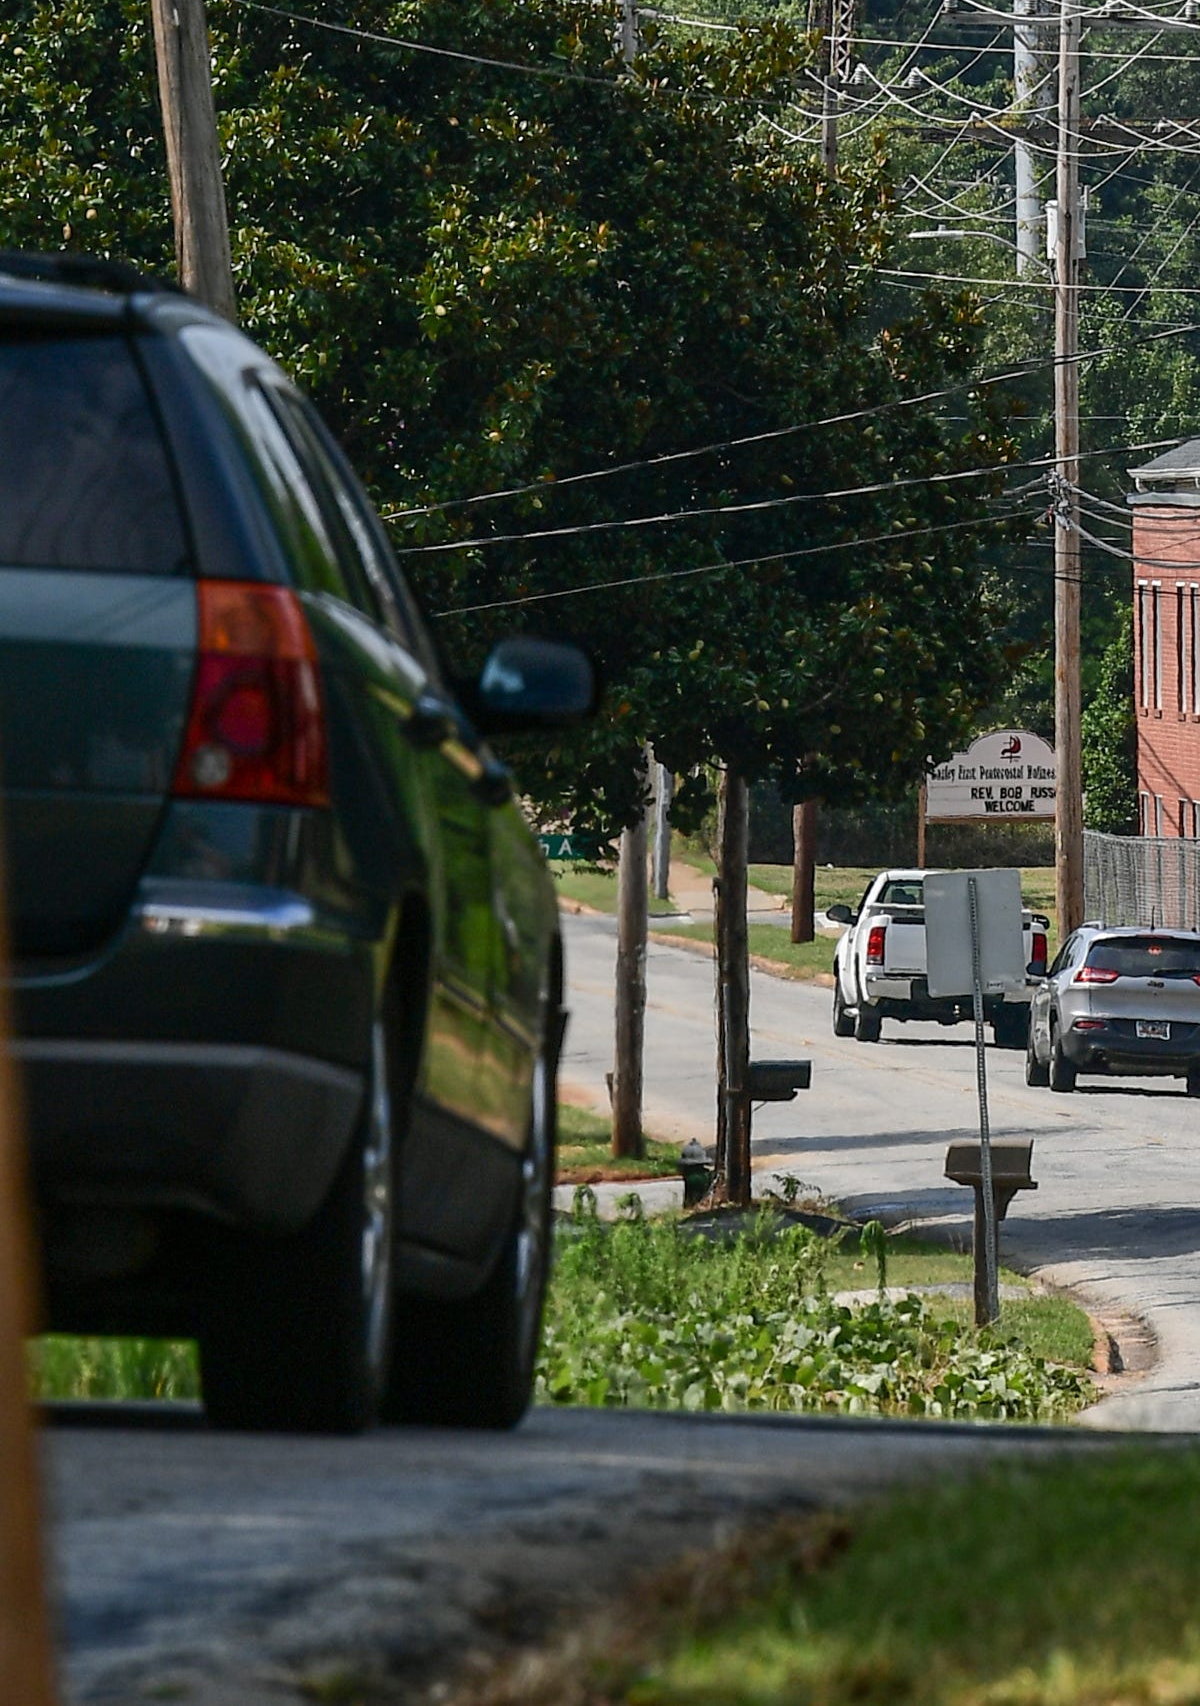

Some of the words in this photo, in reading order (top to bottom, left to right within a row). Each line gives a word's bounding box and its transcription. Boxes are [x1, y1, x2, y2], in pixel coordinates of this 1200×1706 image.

[979, 765, 1024, 780] Pentecostal
[971, 786, 994, 800] REV.
[1000, 786, 1023, 800] BOB
[1030, 787, 1057, 799] RUSS
[985, 800, 1035, 813] WELCOME
